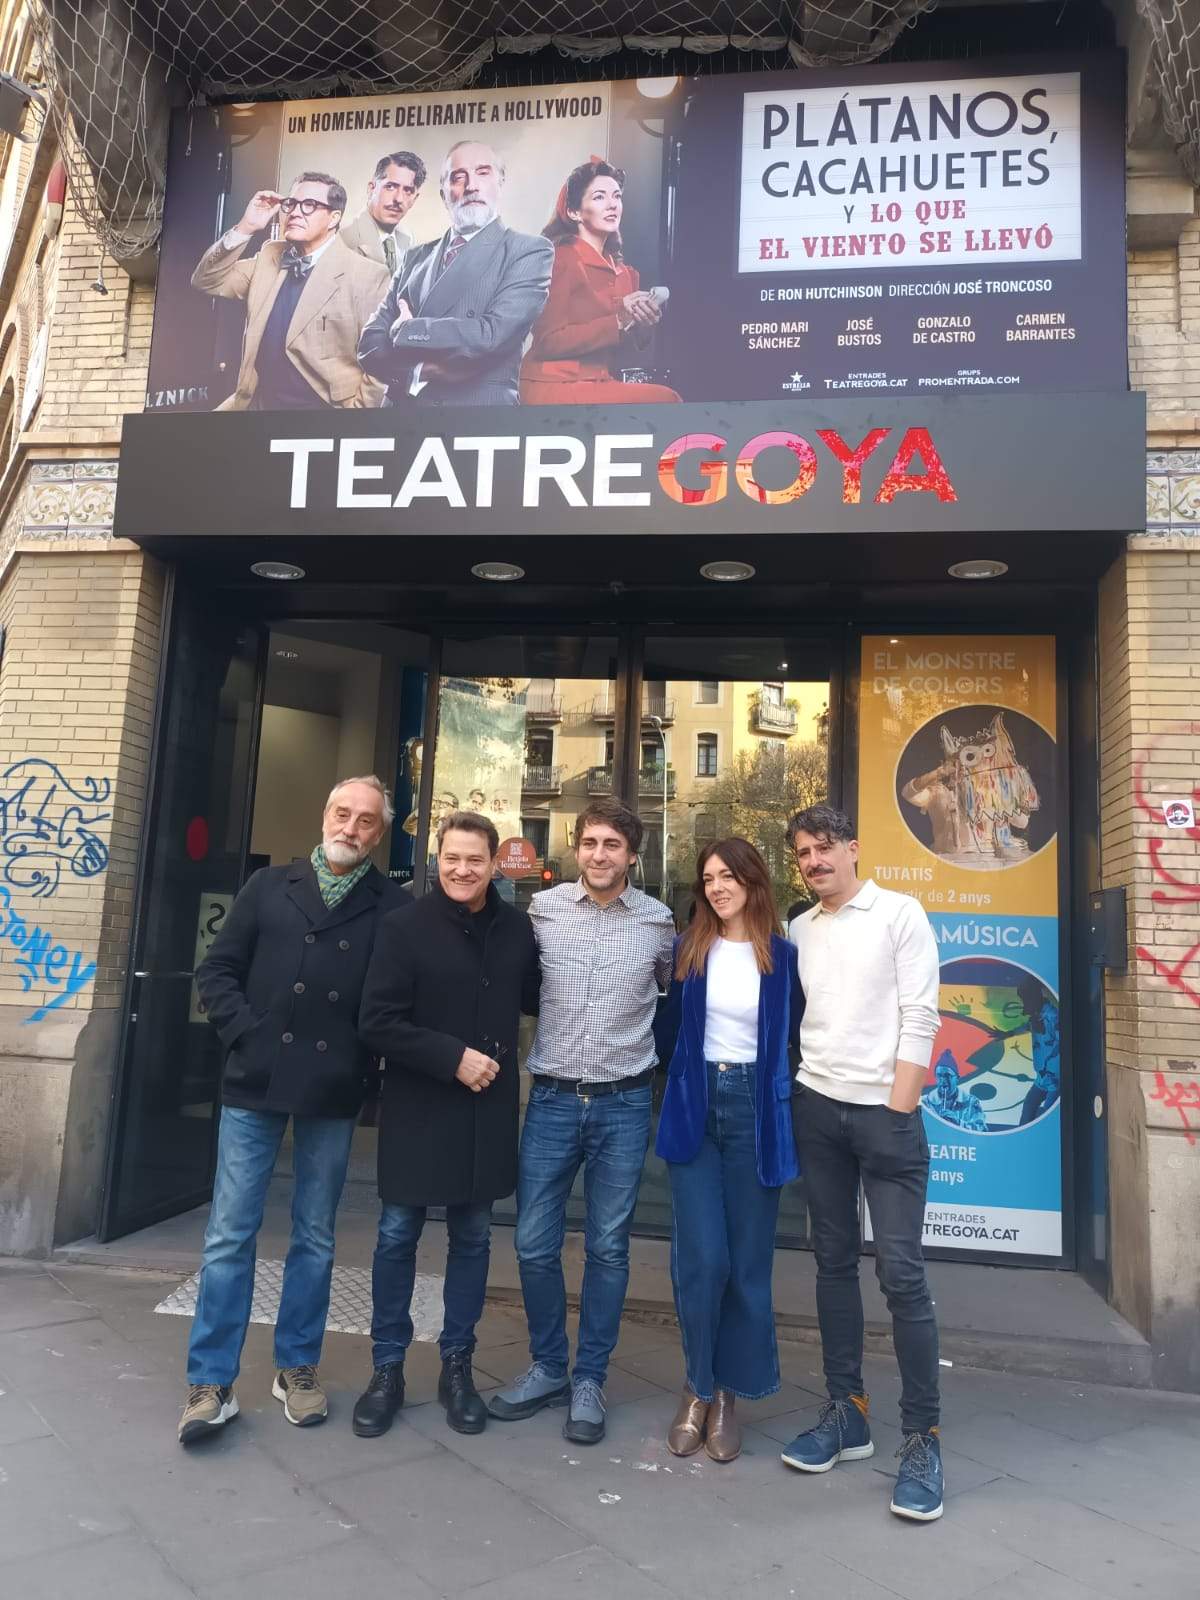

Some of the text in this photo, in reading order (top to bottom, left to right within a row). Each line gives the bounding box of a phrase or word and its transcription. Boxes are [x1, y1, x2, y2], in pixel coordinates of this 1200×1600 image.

[288, 97, 602, 133] UN HOMENAJE DELIRANTE A HOLLYWOOD
[763, 88, 1058, 149] PLÁTANOS,
[761, 148, 1050, 198] CACAHUETES
[843, 199, 966, 225] Y LO QUE
[758, 222, 1053, 260] EL VIENTO SE LLEVÓ
[760, 279, 1052, 301] DE RON HUTCHINSON DIRECCIÓN JOSÉ TRONCOSO
[845, 317, 873, 331] JOSÉ
[917, 316, 971, 329] GONZALO
[1016, 313, 1065, 326] CARMEN
[741, 321, 809, 334] PEDRO MARI
[1006, 328, 1076, 341] BARRANTES
[748, 336, 800, 350] SÁNCHEZ
[837, 334, 882, 346] BUSTOS
[912, 331, 976, 344] DE CASTRO
[824, 378, 908, 389] TEATREGOYA.CAT
[918, 376, 1020, 386] PROMENTRADA.COM
[874, 652, 1016, 670] EL MONSTRE
[873, 676, 1004, 694] DE COLORS
[874, 866, 933, 881] TUTATIS
[927, 890, 944, 902] de
[947, 889, 956, 903] 2
[959, 893, 991, 907] anys
[931, 1169, 964, 1186] anys
[927, 1211, 986, 1224] ENTRADES
